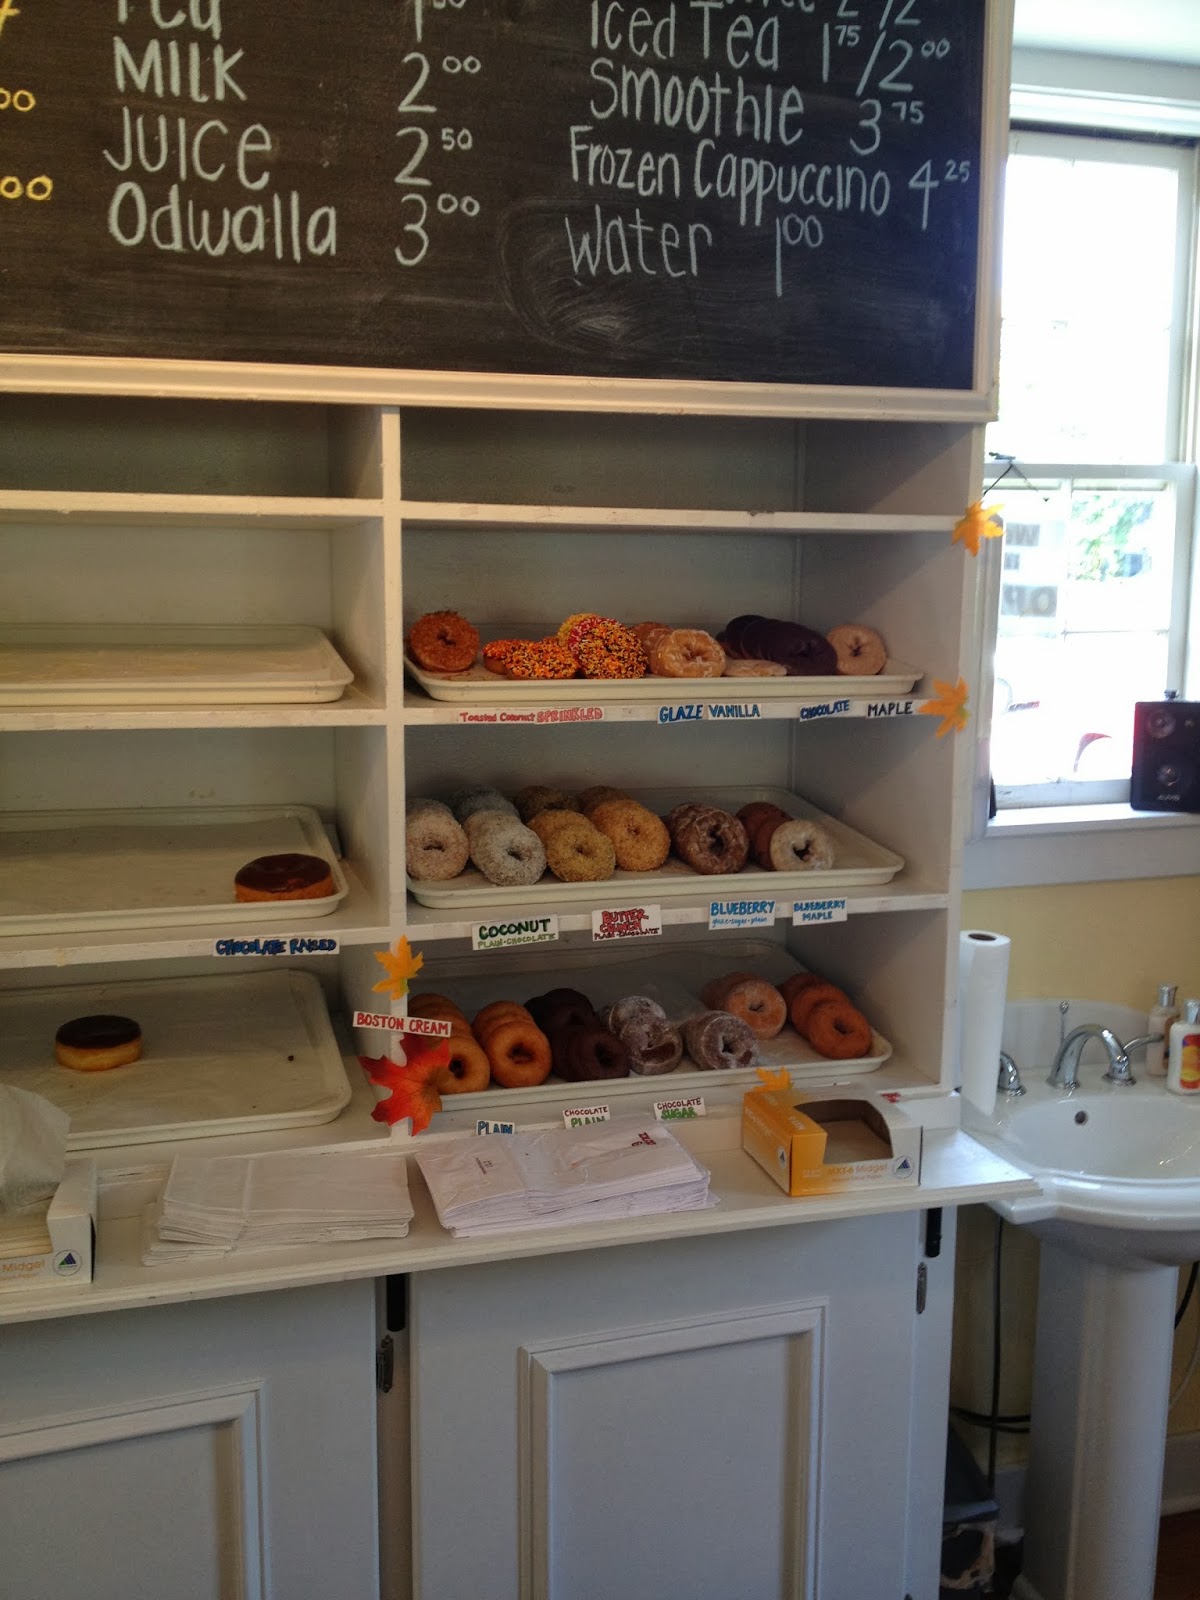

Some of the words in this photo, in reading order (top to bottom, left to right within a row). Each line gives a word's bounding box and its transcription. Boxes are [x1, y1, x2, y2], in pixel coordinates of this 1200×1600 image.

[590, 0, 676, 58] Iced
[690, 1, 779, 71] Tea
[569, 125, 680, 197] Frozen
[694, 138, 890, 226] Cappuccino
[107, 181, 338, 263] Odwalla
[659, 704, 703, 723] GLAZE
[708, 703, 760, 718] VANILLA
[800, 700, 850, 719] CHOCOLATE
[867, 701, 914, 717] MAPLE
[710, 901, 775, 916] BLUEBERRY
[802, 911, 833, 922] MAPLE
[479, 918, 551, 940] COCONUT
[356, 1012, 404, 1031] BOSTON
[408, 1019, 449, 1035] CREAM
[564, 1106, 608, 1117] CHOCOLATE
[656, 1097, 702, 1110] CHOCOLATE
[660, 1106, 698, 1120] SUGAR
[477, 1120, 513, 1135] PLAIN
